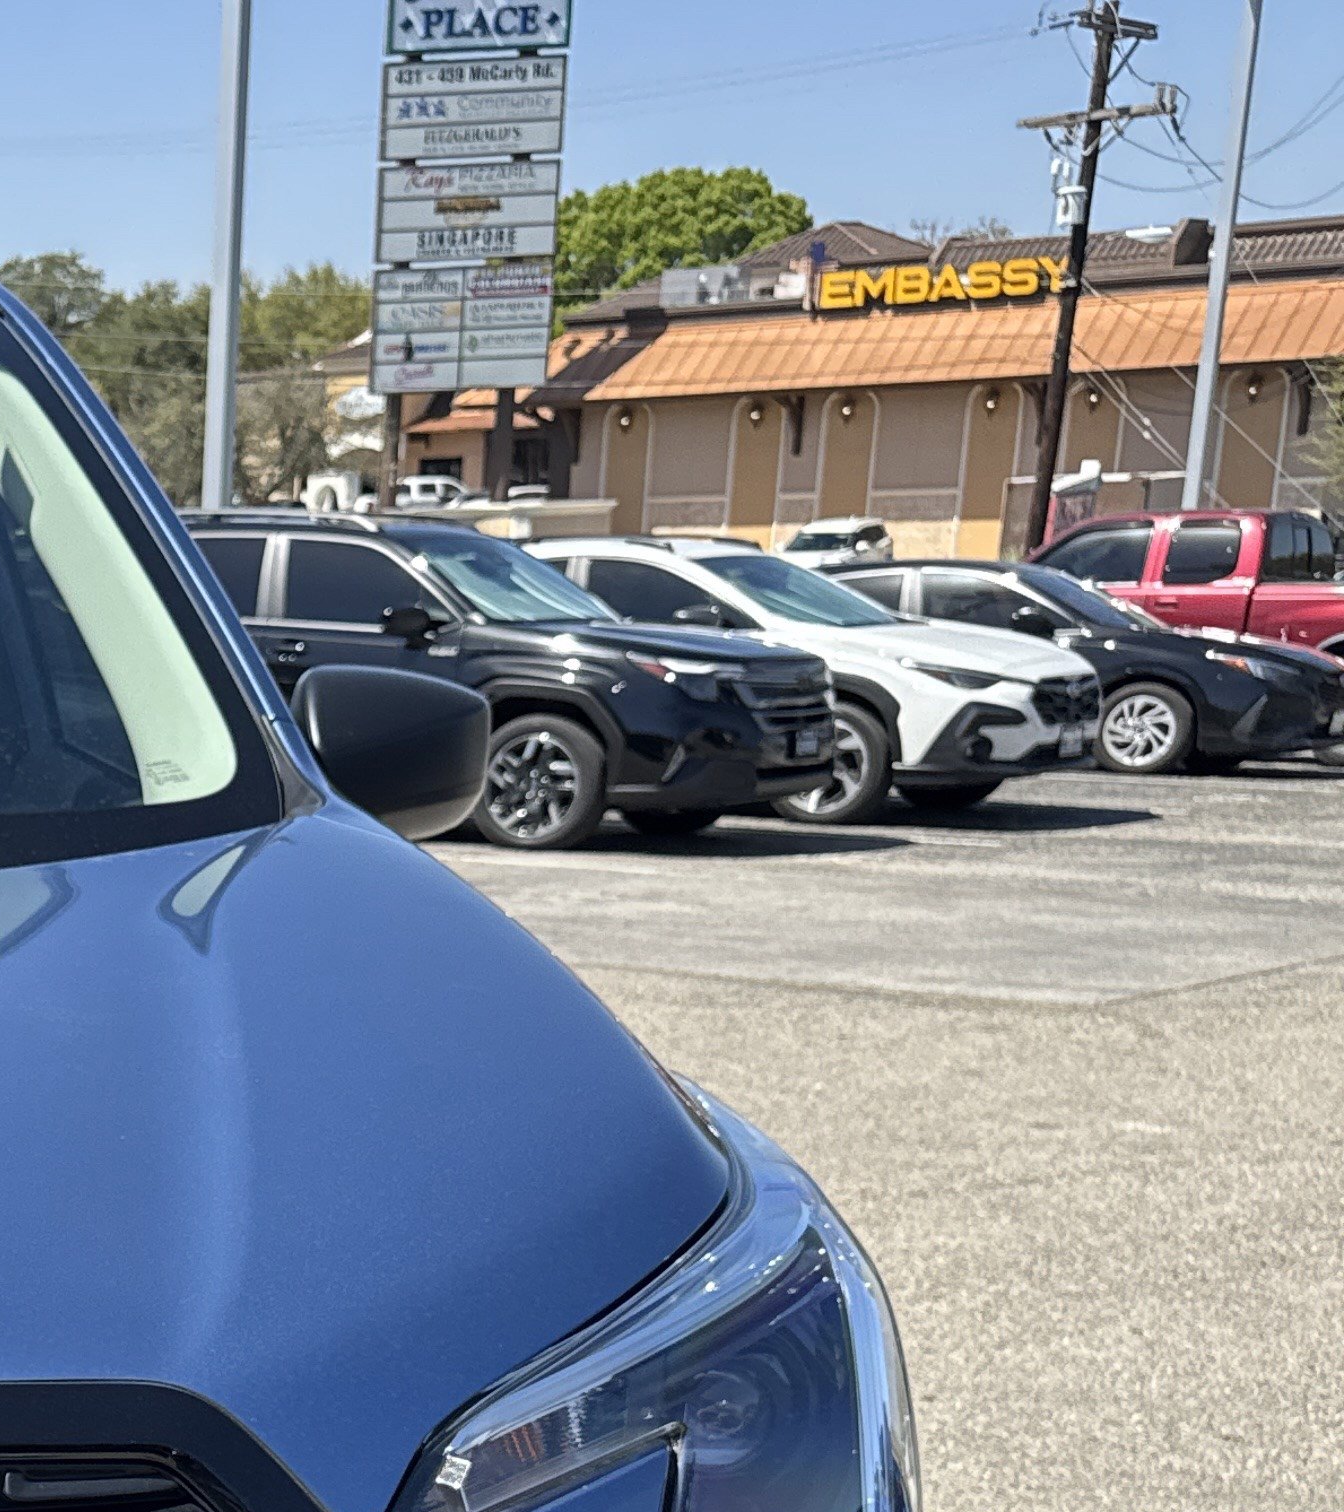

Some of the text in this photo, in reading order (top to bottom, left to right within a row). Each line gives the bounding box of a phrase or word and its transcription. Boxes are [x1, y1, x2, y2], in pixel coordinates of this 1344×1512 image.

[421, 5, 540, 39] PLACE
[417, 228, 518, 248] SINGAPORE
[819, 255, 1070, 310] EMBASSY
